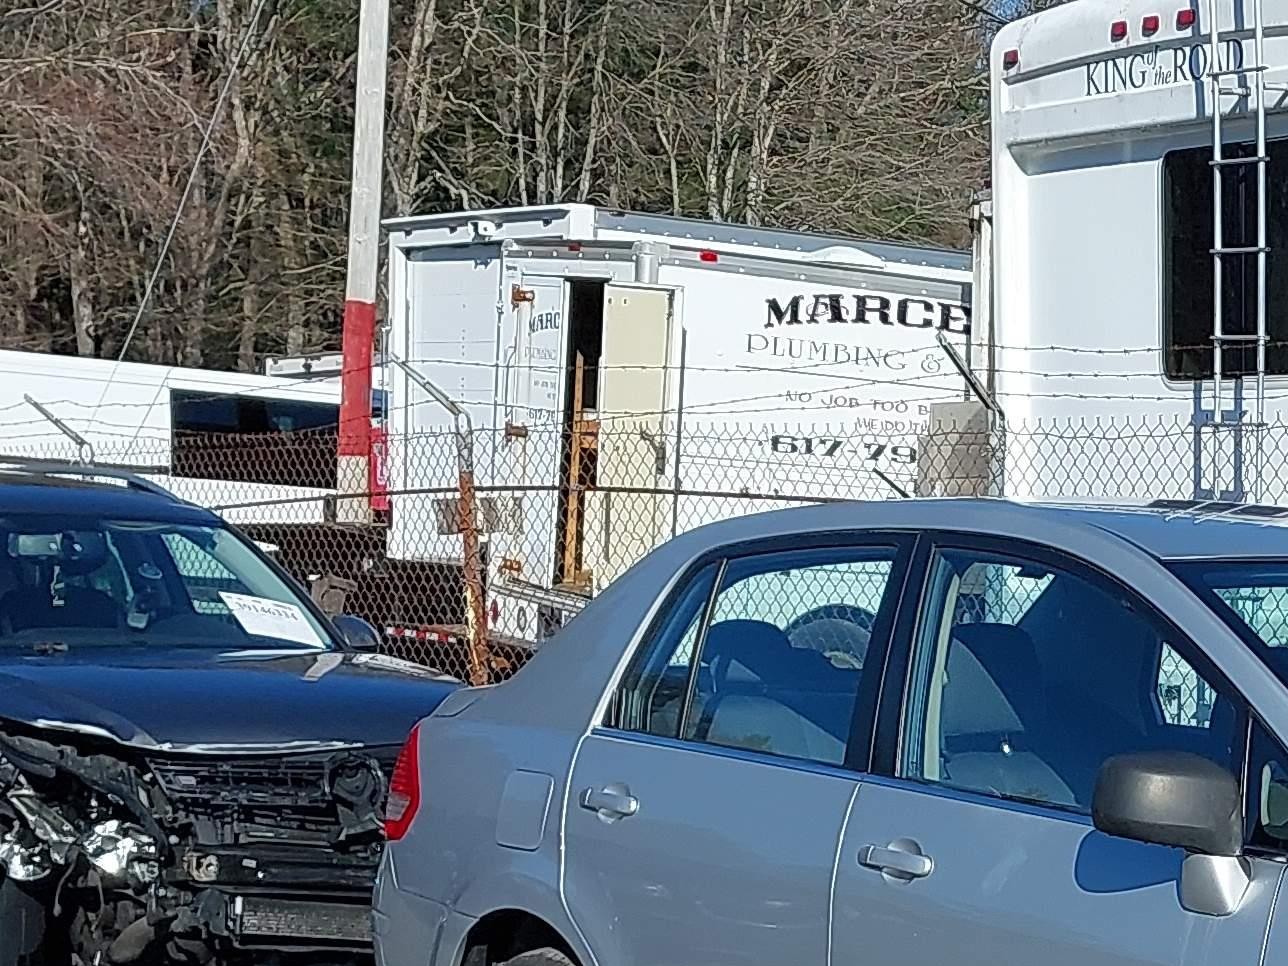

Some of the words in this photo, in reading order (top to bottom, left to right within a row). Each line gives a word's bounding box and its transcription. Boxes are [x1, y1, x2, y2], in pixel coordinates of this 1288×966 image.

[1085, 53, 1148, 97] KING
[1146, 45, 1161, 70] of
[1153, 65, 1172, 86] the
[1173, 39, 1244, 83] ROAD
[763, 293, 972, 336] MARCE
[745, 333, 908, 371] PLUMBING
[920, 353, 945, 374] &
[785, 389, 812, 403] NO
[820, 394, 860, 409] JOB
[872, 399, 909, 414] TOO
[770, 434, 918, 465] 617-79
